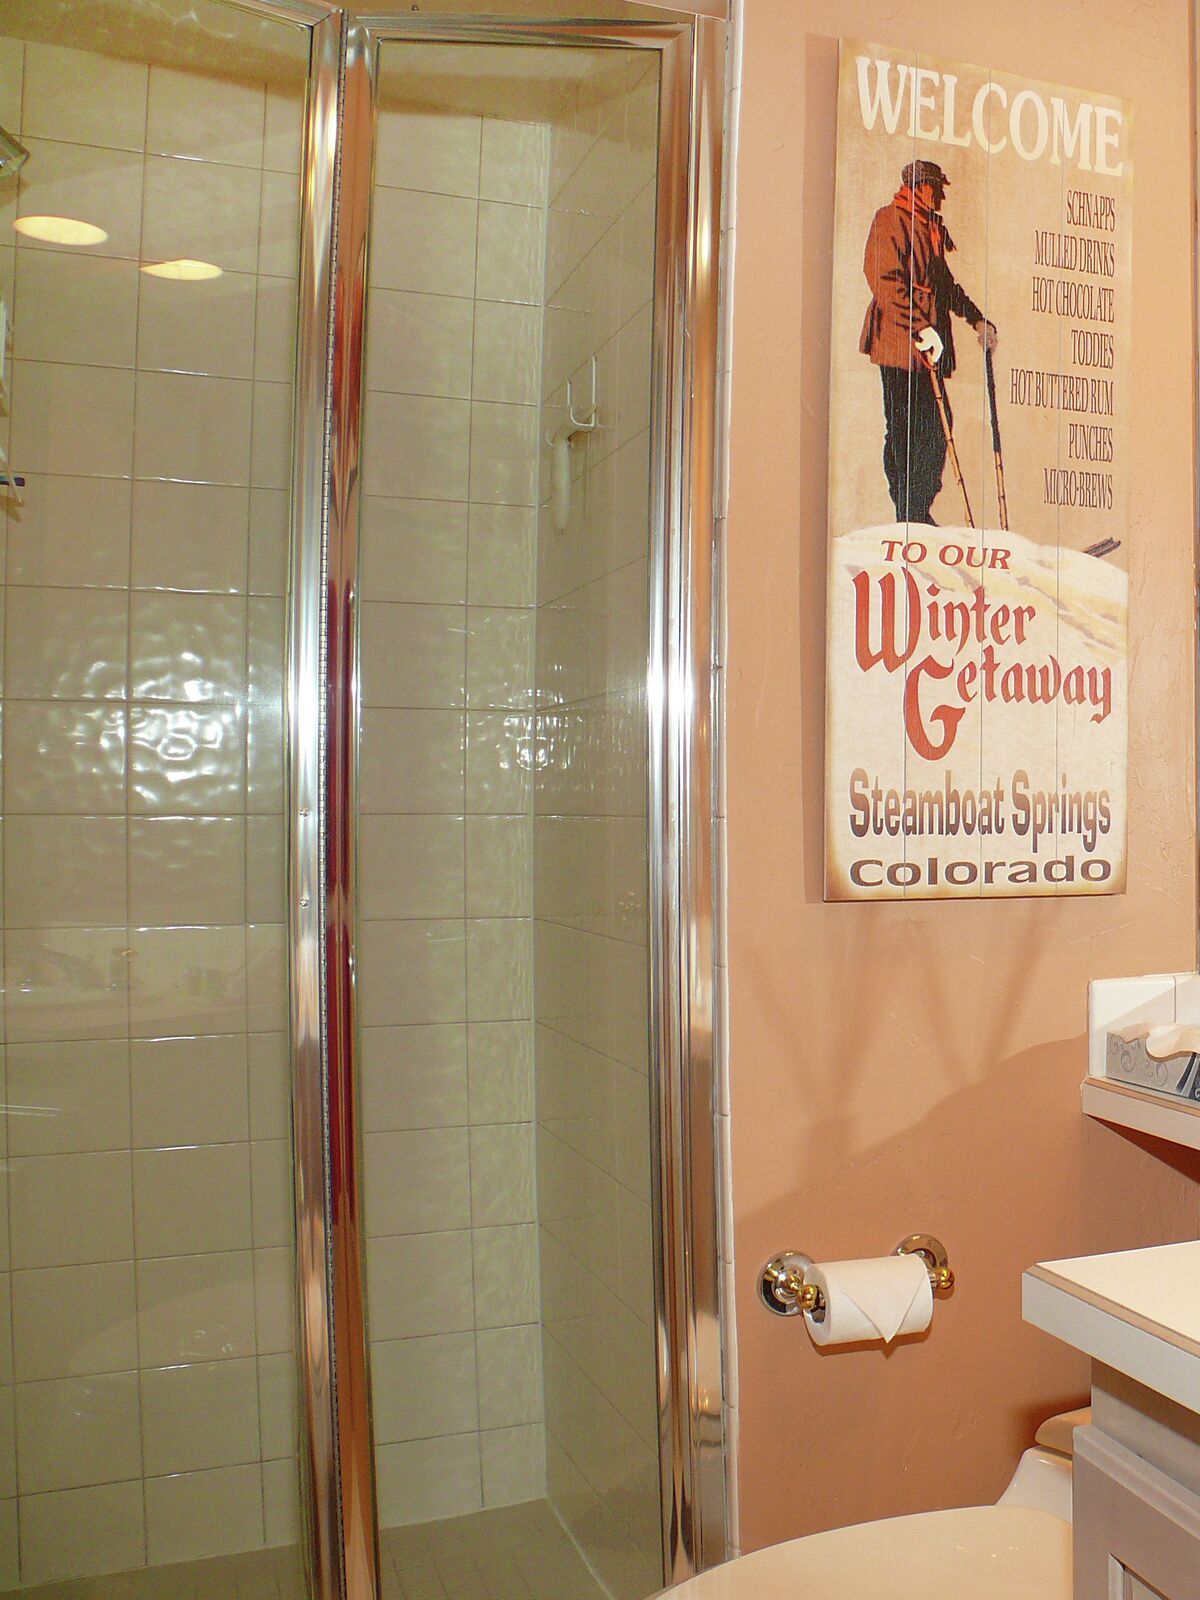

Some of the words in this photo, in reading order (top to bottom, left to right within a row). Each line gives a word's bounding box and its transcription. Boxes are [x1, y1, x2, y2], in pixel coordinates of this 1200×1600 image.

[856, 56, 1124, 177] WELCOME
[1066, 189, 1115, 231] SCHNAPPS
[1034, 230, 1076, 270] MULLED
[1079, 238, 1115, 278] DRINKS
[1032, 276, 1054, 314] HOT
[1056, 280, 1114, 323] CHOCOLATE
[1071, 329, 1114, 370] TODDIES
[1010, 368, 1033, 406] HOT
[1034, 372, 1089, 412] BUTTERED
[1090, 378, 1114, 416] RUM
[1068, 423, 1113, 463] PUNCHES
[881, 539, 928, 563] TO
[938, 545, 1012, 570] OUR
[852, 566, 1037, 673] Winter
[903, 644, 1112, 761] Getaway
[849, 767, 1005, 838] Steamboat
[1011, 769, 1112, 854] Springs
[849, 855, 1112, 888] Colorado
